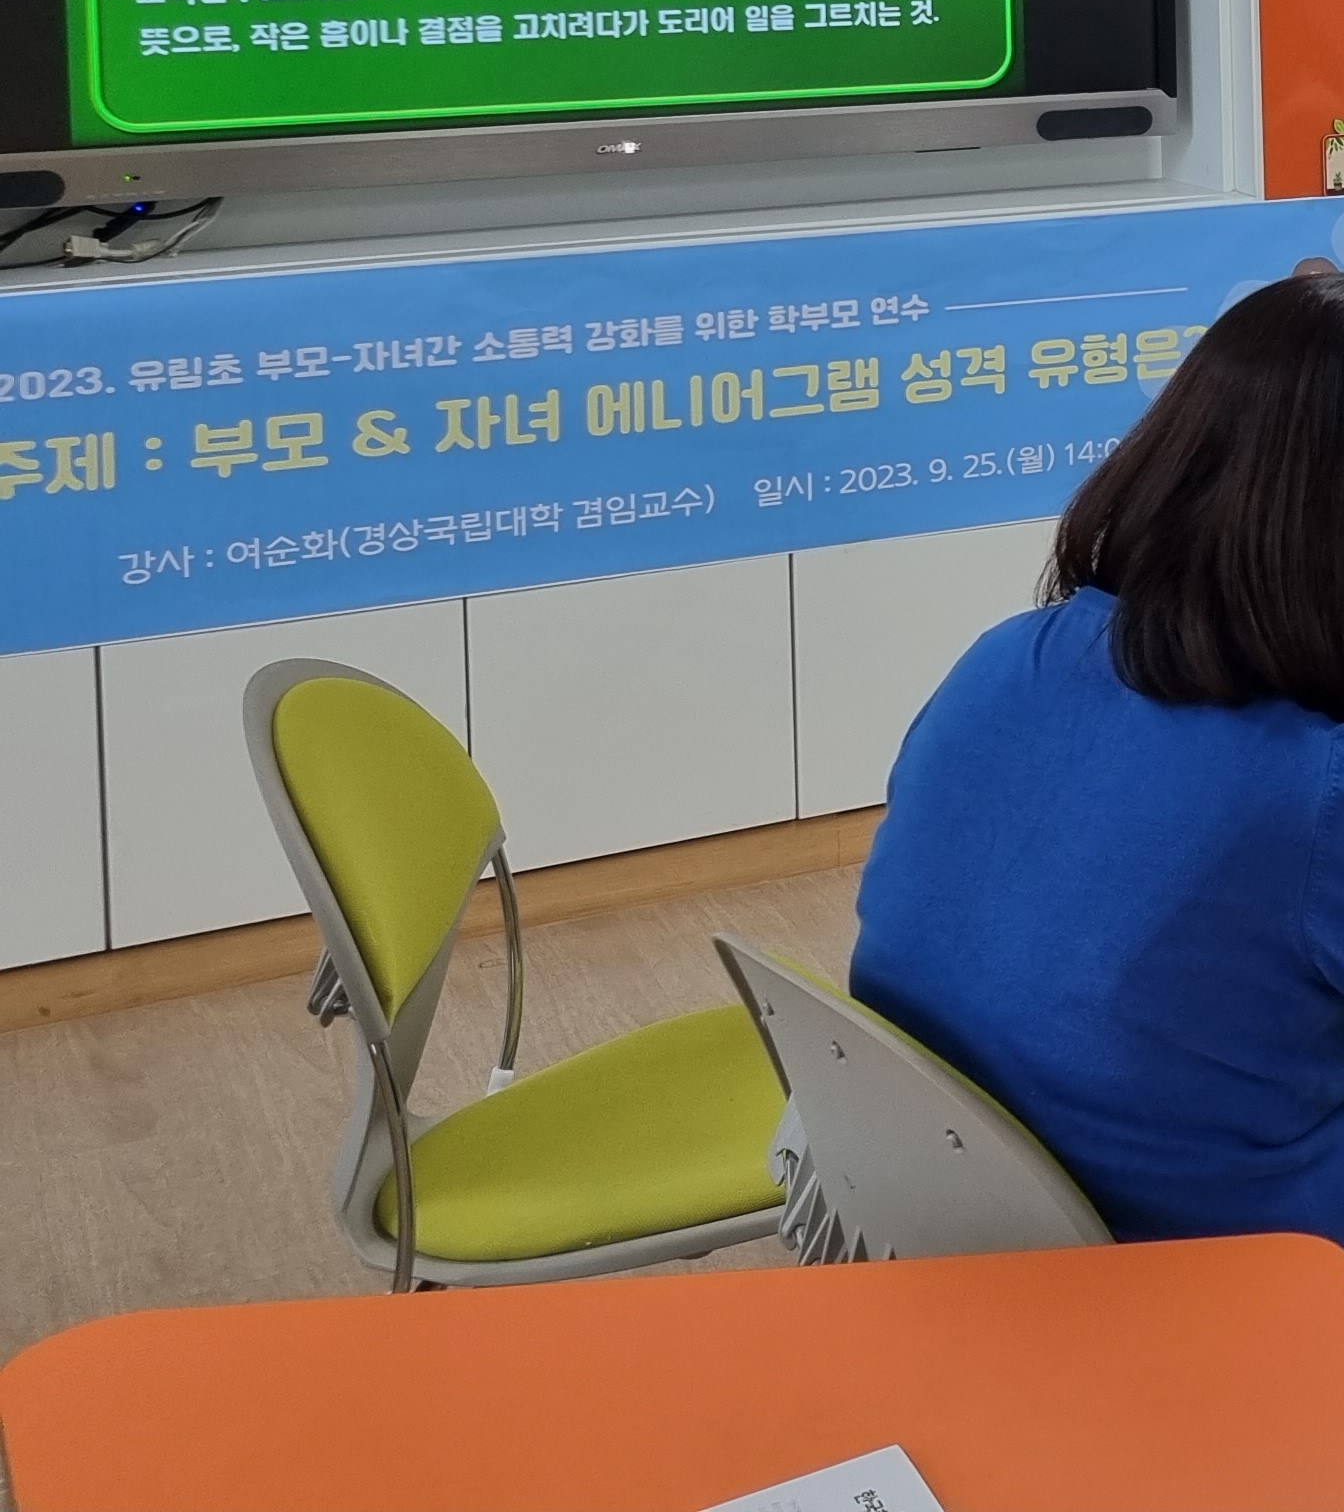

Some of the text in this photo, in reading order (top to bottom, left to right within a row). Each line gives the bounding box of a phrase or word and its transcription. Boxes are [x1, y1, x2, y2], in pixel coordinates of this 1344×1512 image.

[140, 0, 939, 55] 뜻으로, 작은 흠이나 결점을 고치려다가 도리어 일을 그르치는 것.
[0, 294, 929, 402] 2023. 유림초 부모-자녀간 소통력 강화를 위한 학부모 연수
[0, 432, 115, 499] 주제
[191, 413, 328, 477] 부모
[353, 410, 410, 456] &
[436, 389, 559, 452] 자녀
[587, 357, 879, 436] 에니어그램
[901, 345, 1005, 403] 성격
[119, 546, 194, 584] 강사
[227, 503, 563, 569] 여순화(경상국립대학
[573, 485, 714, 528] 겸임교수)
[755, 473, 812, 507] 일시
[840, 463, 917, 493] 2023.
[929, 459, 952, 482] 9.
[964, 444, 1054, 478] 25.(월)
